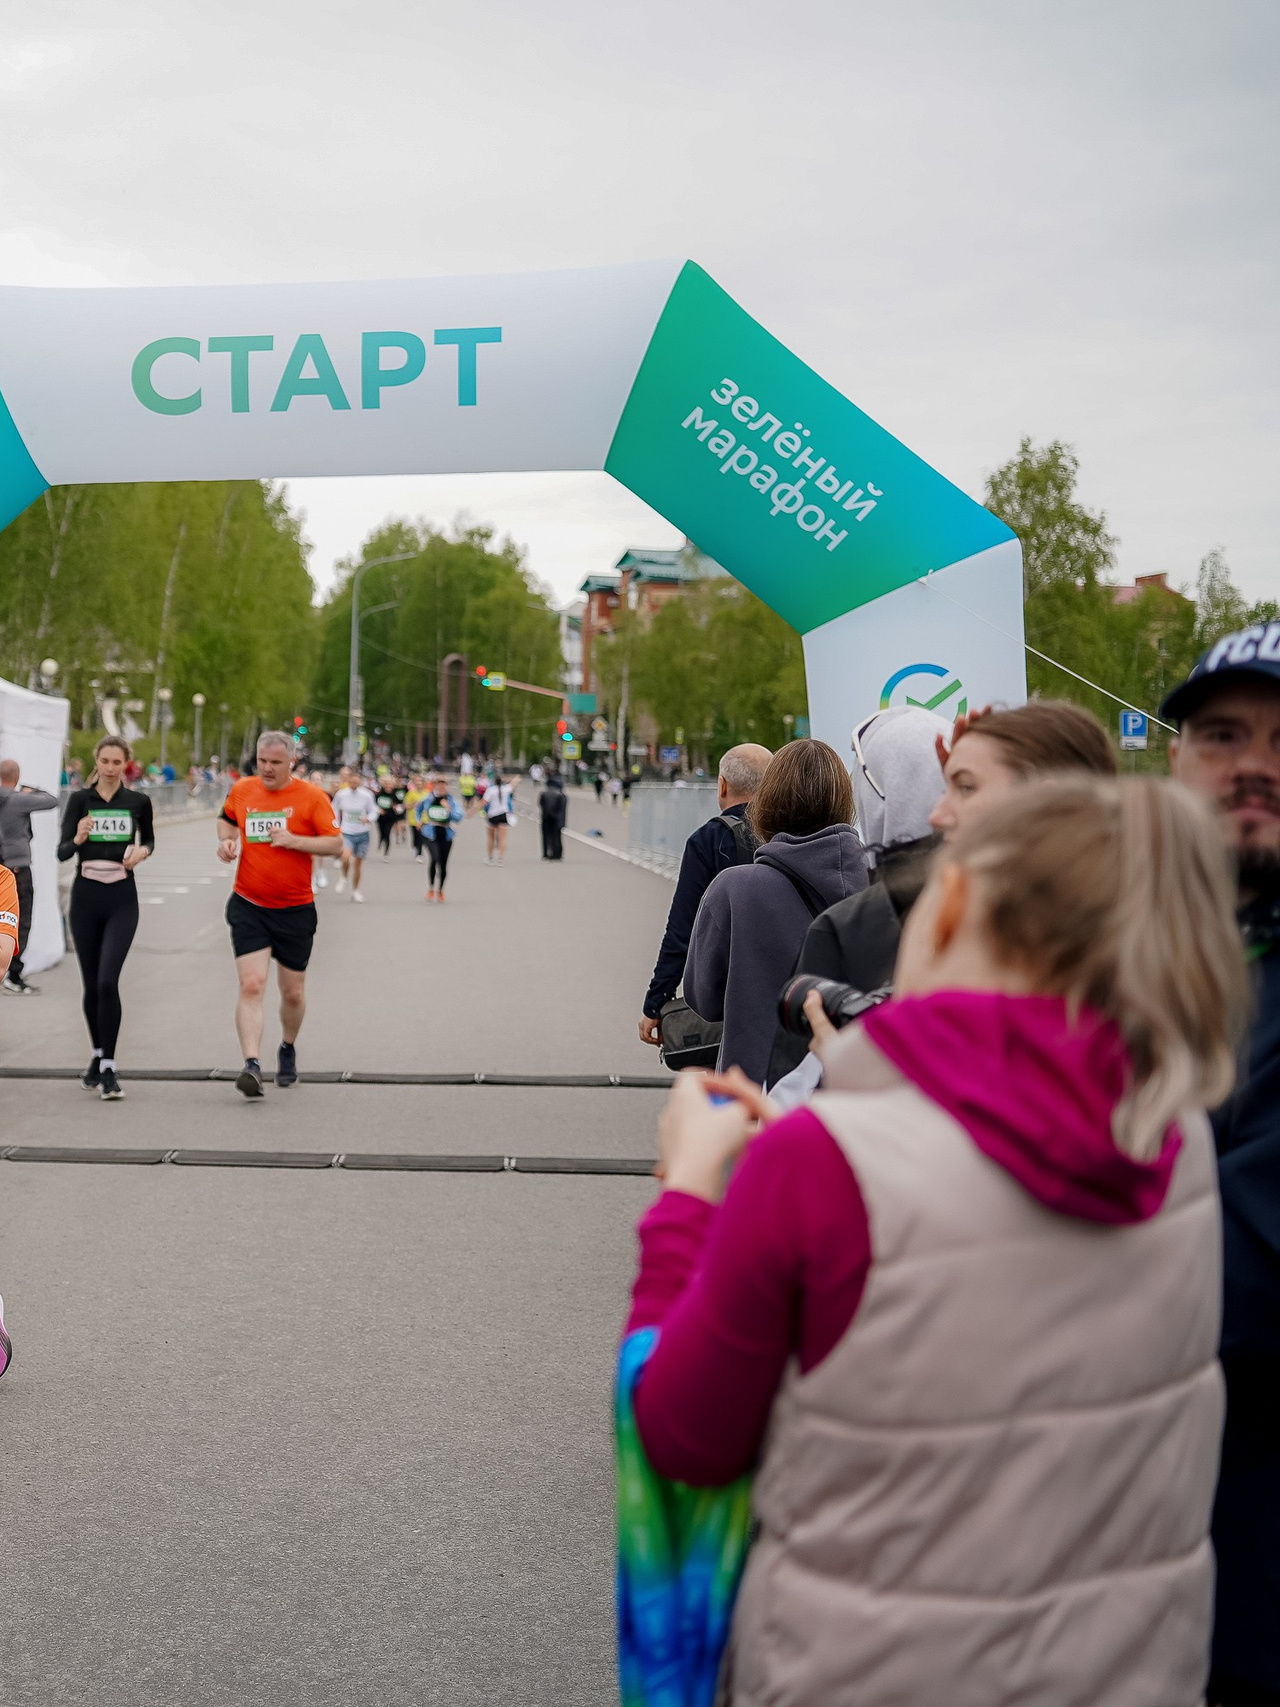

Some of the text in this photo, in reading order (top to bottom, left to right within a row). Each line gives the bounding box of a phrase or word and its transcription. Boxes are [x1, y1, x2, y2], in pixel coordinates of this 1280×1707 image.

[131, 326, 502, 416] СТАРТ
[681, 406, 850, 552] марафон
[710, 377, 884, 523] зелёный
[1128, 714, 1143, 735] P
[95, 820, 126, 831] 1416
